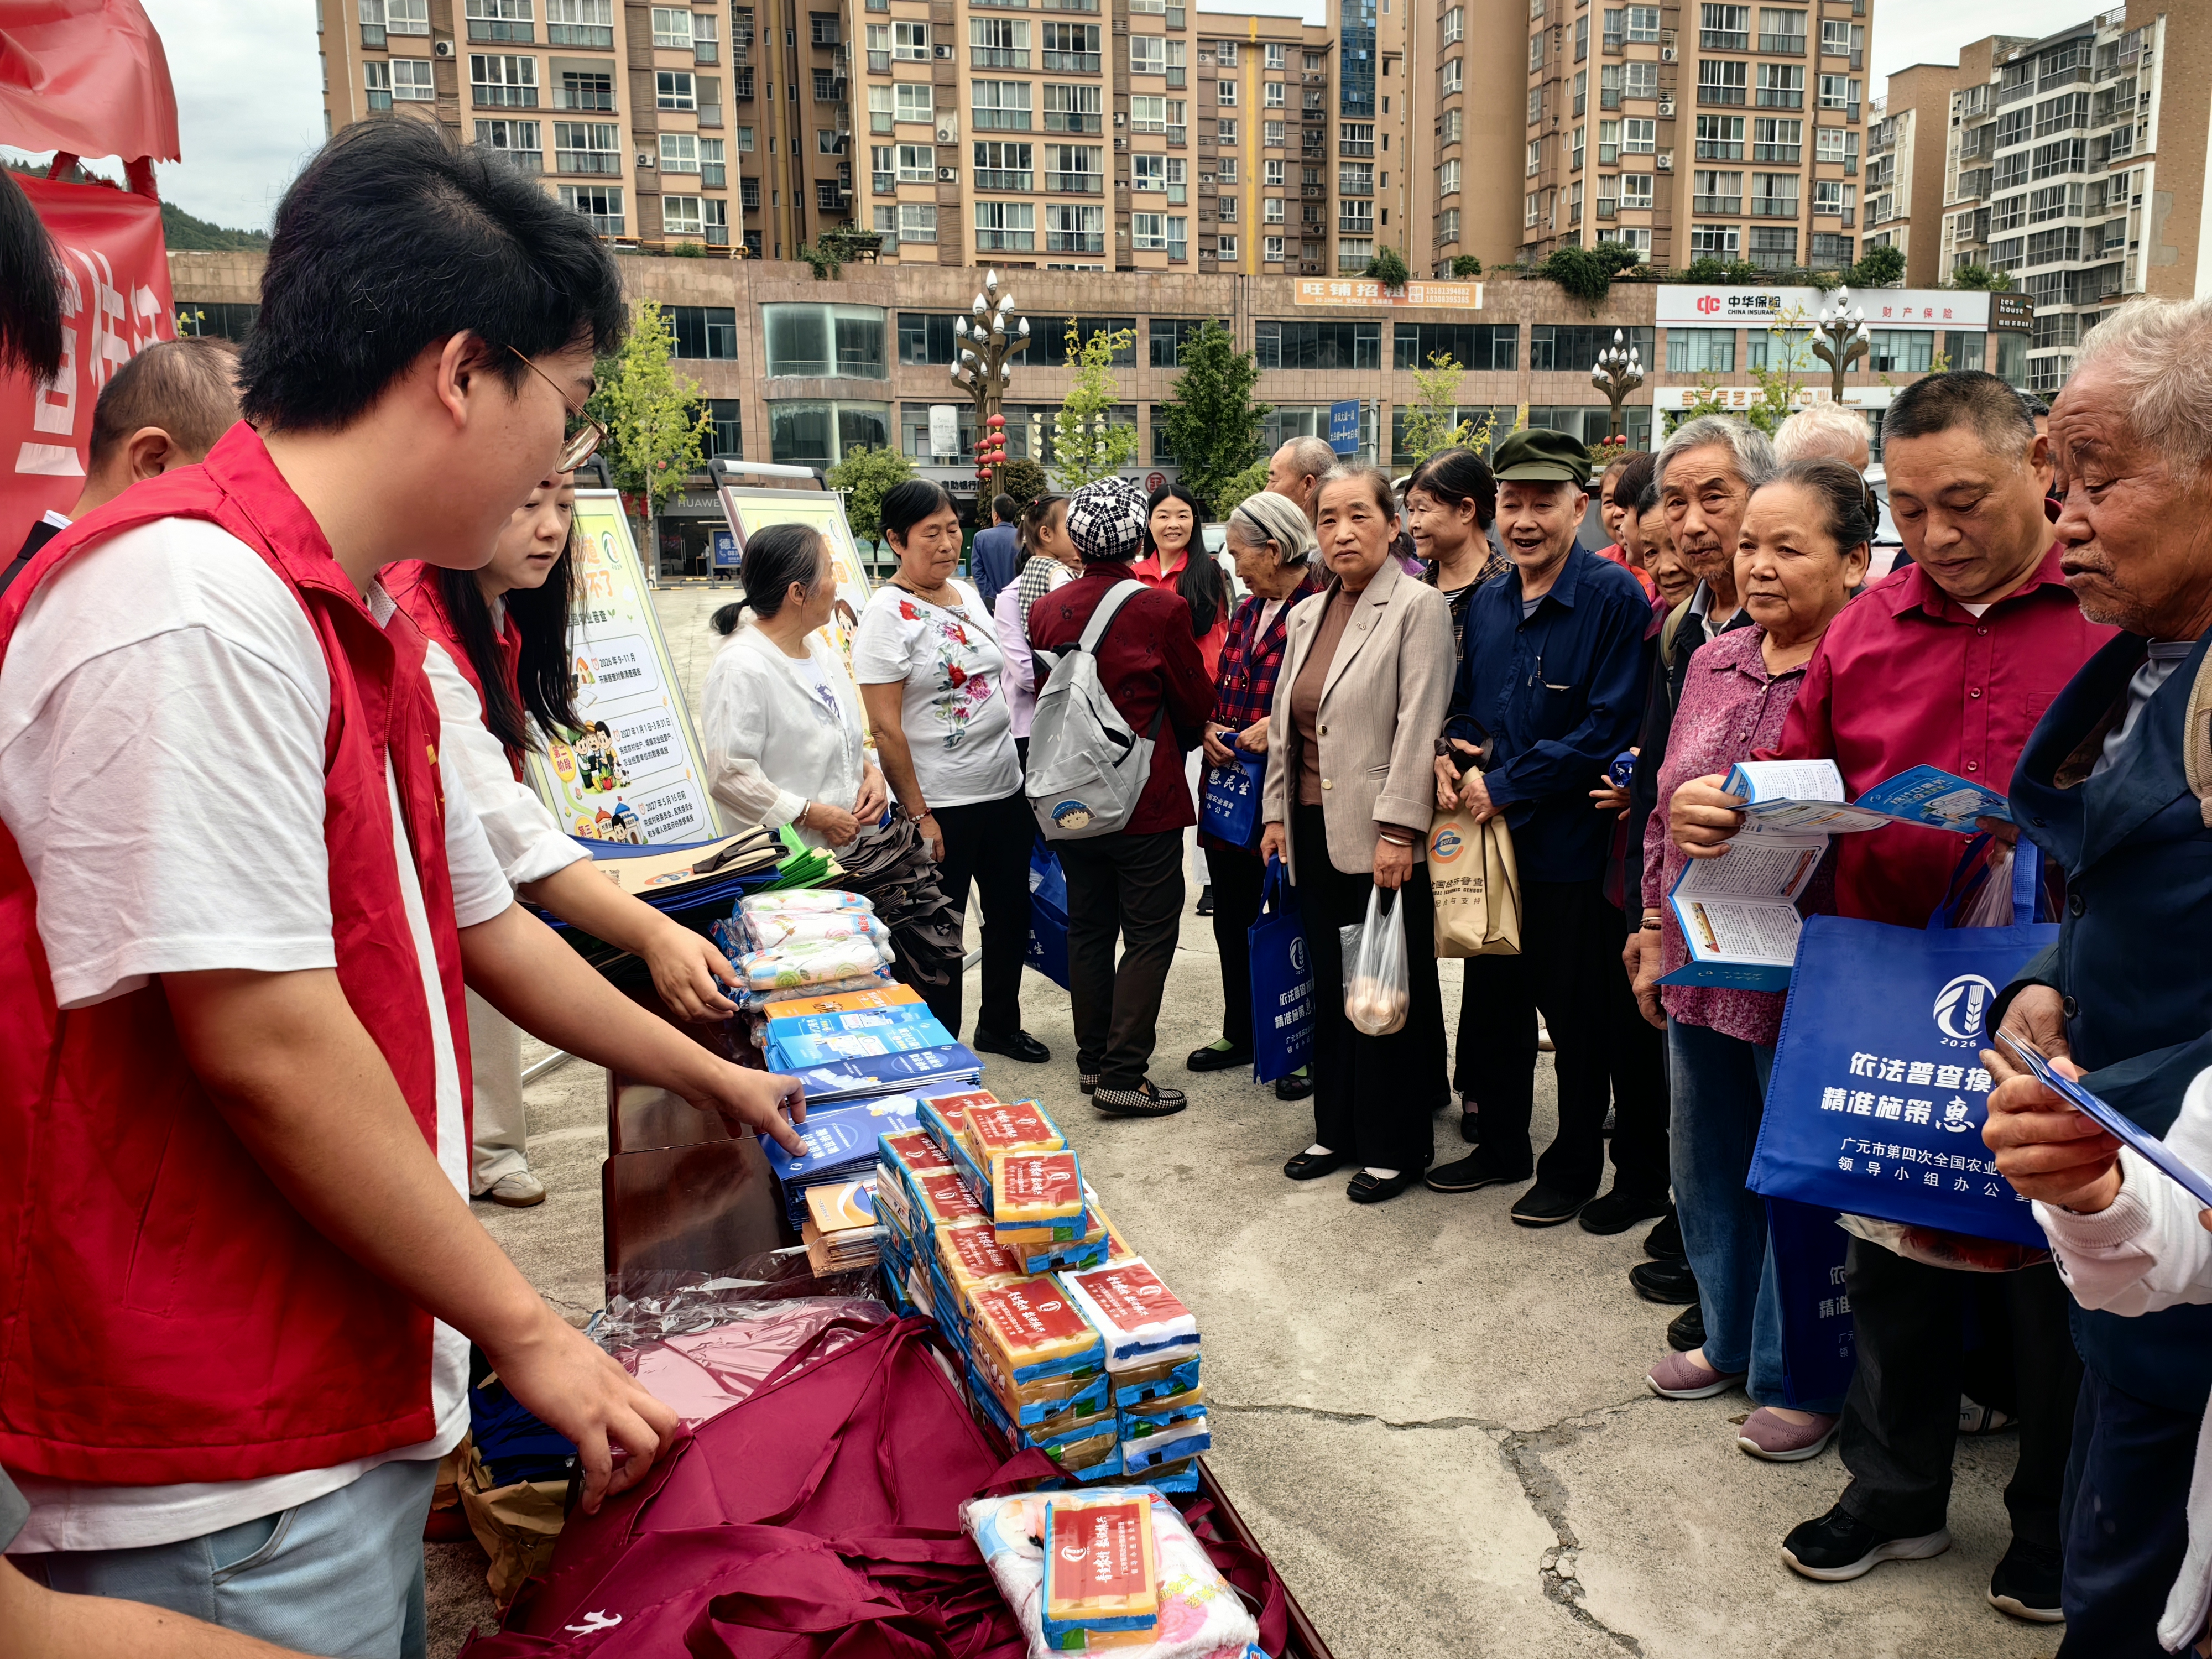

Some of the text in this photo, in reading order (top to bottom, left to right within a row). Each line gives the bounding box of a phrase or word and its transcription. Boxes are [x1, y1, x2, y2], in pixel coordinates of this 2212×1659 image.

[1302, 283, 1405, 298] 旺铺招租
[1728, 295, 1781, 308] 中华保险
[1882, 306, 1953, 319] 财产保险
[2000, 305, 2023, 314] house
[1209, 769, 1250, 796] 惠民生
[1206, 802, 1231, 818] 办公室
[1940, 1037, 1976, 1047] 2026
[1819, 1295, 1851, 1318] 精准
